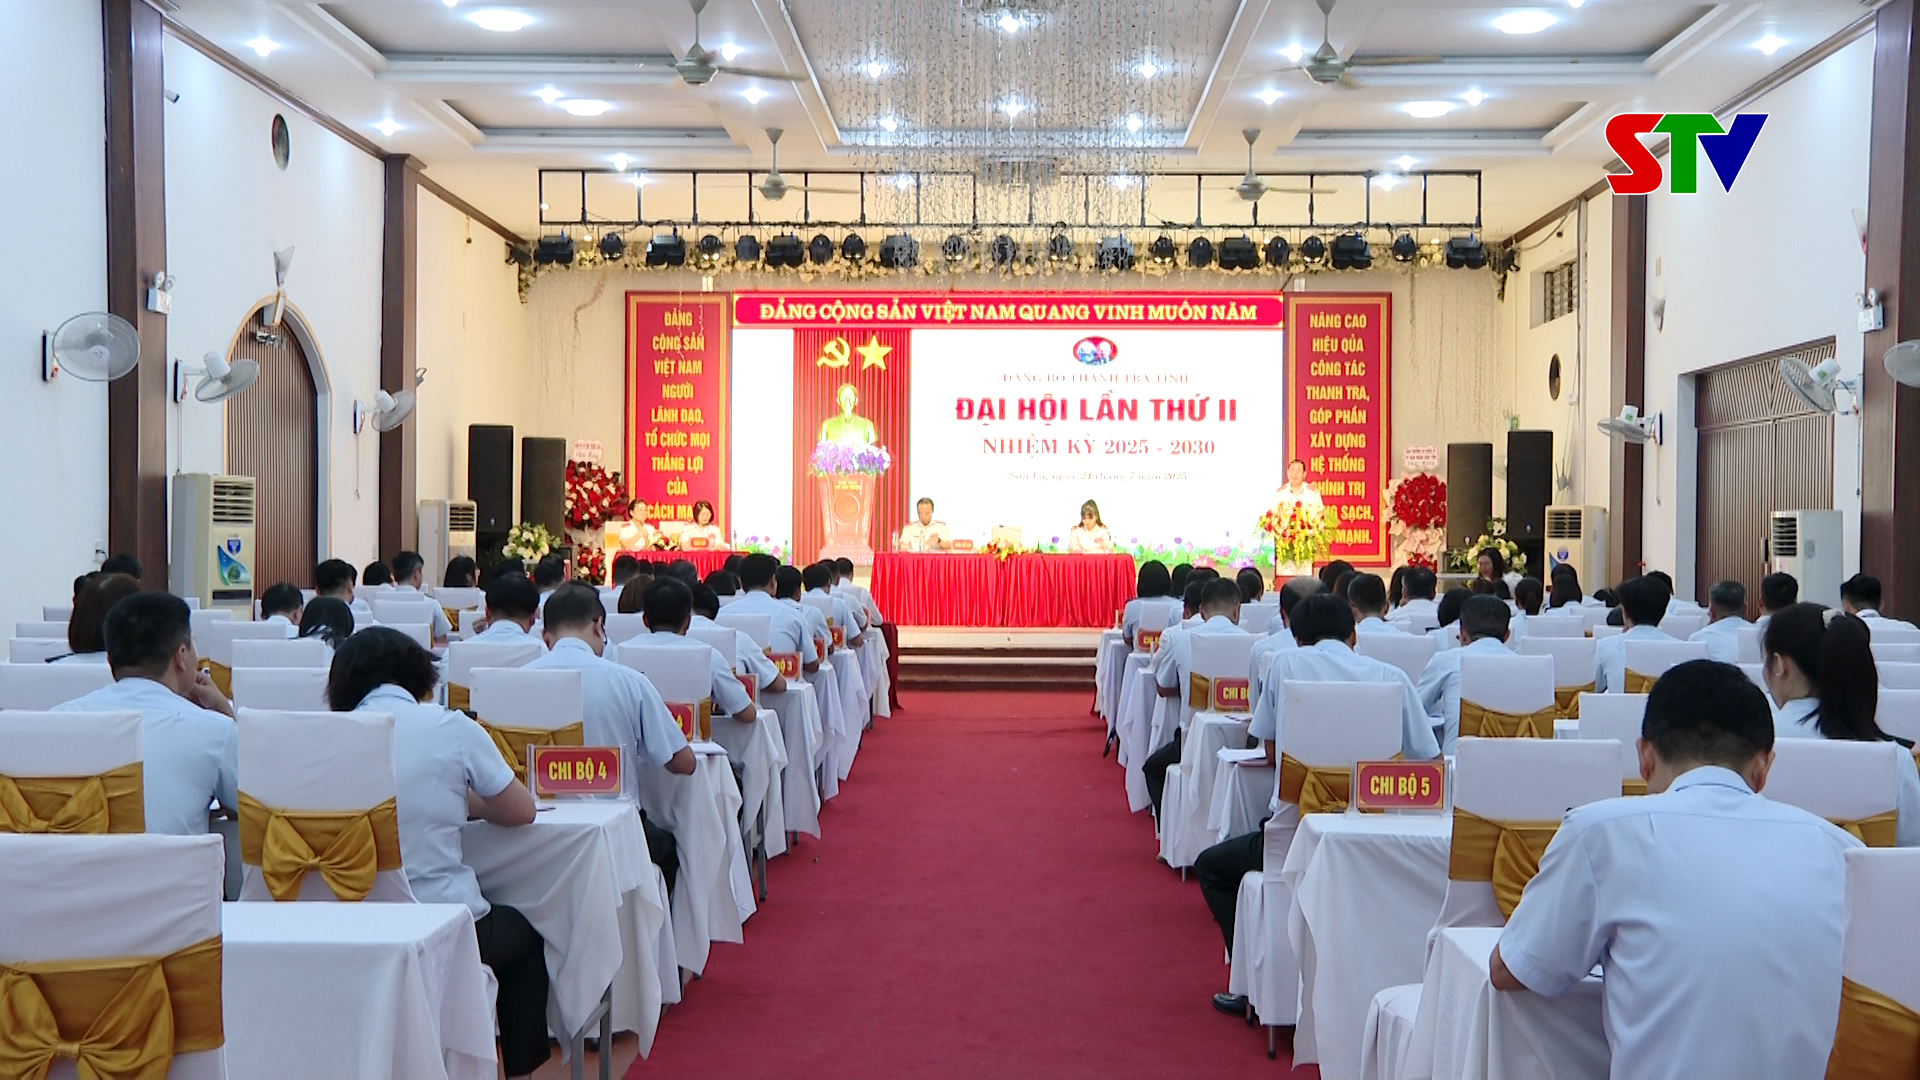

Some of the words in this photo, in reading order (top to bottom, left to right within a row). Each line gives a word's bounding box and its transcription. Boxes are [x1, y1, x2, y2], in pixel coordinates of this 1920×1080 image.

[664, 307, 693, 327] ĐẢNG
[760, 297, 816, 319] ĐẢNG
[819, 299, 874, 323] CỘNG
[876, 297, 917, 319] SẢN
[920, 299, 967, 323] VIỆT
[970, 304, 1015, 319] NAM
[1018, 304, 1090, 321] QUANG
[1093, 304, 1144, 320] VINH
[1148, 299, 1206, 320] MUÔN
[1211, 301, 1257, 320] NĂM
[1309, 311, 1341, 328] NÂNG
[1344, 313, 1367, 328] CAO
[652, 333, 680, 353] CỘNG
[683, 332, 704, 351] SẢN
[1312, 335, 1338, 355] HIỆU
[654, 357, 676, 378] VIỆT
[678, 360, 702, 375] NAM
[1310, 359, 1341, 376] CÔNG
[1344, 359, 1366, 376] TÁC
[662, 381, 694, 399] NGƯỜI
[1305, 385, 1343, 400] THANH
[1346, 385, 1371, 402] TRA,
[955, 397, 1005, 426] ĐẠI
[1018, 393, 1067, 426] HỘI
[1080, 389, 1138, 421] LẦN
[1149, 393, 1210, 421] THỨ
[1219, 399, 1236, 421] II
[1309, 406, 1332, 424] GÓP
[660, 429, 687, 447] CHỨC
[690, 432, 710, 450] MỌI
[983, 433, 1057, 459] NHIỆM
[1068, 433, 1095, 454] KỲ
[1104, 439, 1148, 455] 2025
[1170, 439, 1215, 455] 2030
[1310, 430, 1332, 448] XÂY
[1334, 432, 1366, 452] DỰNG
[687, 455, 704, 474] LỢI
[1311, 454, 1325, 476] HỆ
[1328, 452, 1366, 472] THỐNG
[666, 475, 688, 496] CỦA
[1347, 481, 1366, 500] TRỊ
[646, 501, 674, 520] CÁCH
[677, 504, 694, 522] MẠ
[1341, 505, 1374, 523] SẠCH,
[1223, 687, 1238, 700] CHI
[1240, 687, 1249, 700] B
[548, 761, 572, 780] CHI
[575, 757, 595, 784] BỘ
[598, 761, 607, 780] 4
[1370, 775, 1394, 796] CHI
[1398, 772, 1418, 800] BỘ
[1421, 777, 1430, 796] 5
